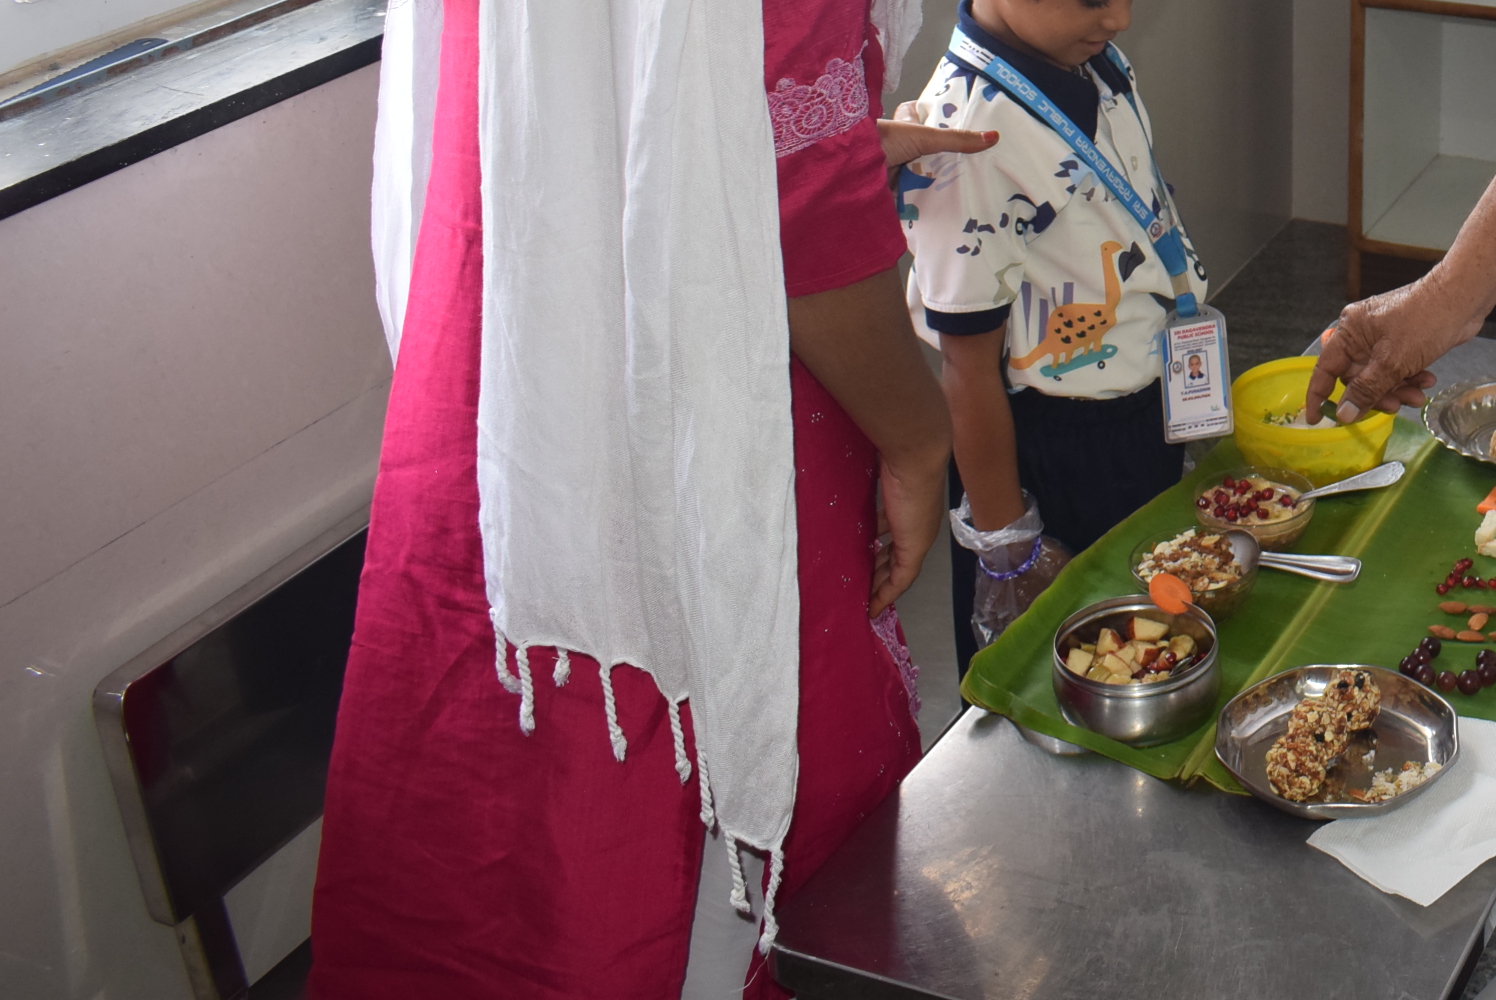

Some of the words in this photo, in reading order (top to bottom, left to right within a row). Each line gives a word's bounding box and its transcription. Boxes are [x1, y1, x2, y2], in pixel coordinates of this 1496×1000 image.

[995, 62, 1038, 101] SCHOOL
[1037, 99, 1075, 137] PUBLIC
[1075, 135, 1134, 203] RAGAVENDRA
[1132, 201, 1149, 220] SRI
[1194, 329, 1214, 337] SCHOOL
